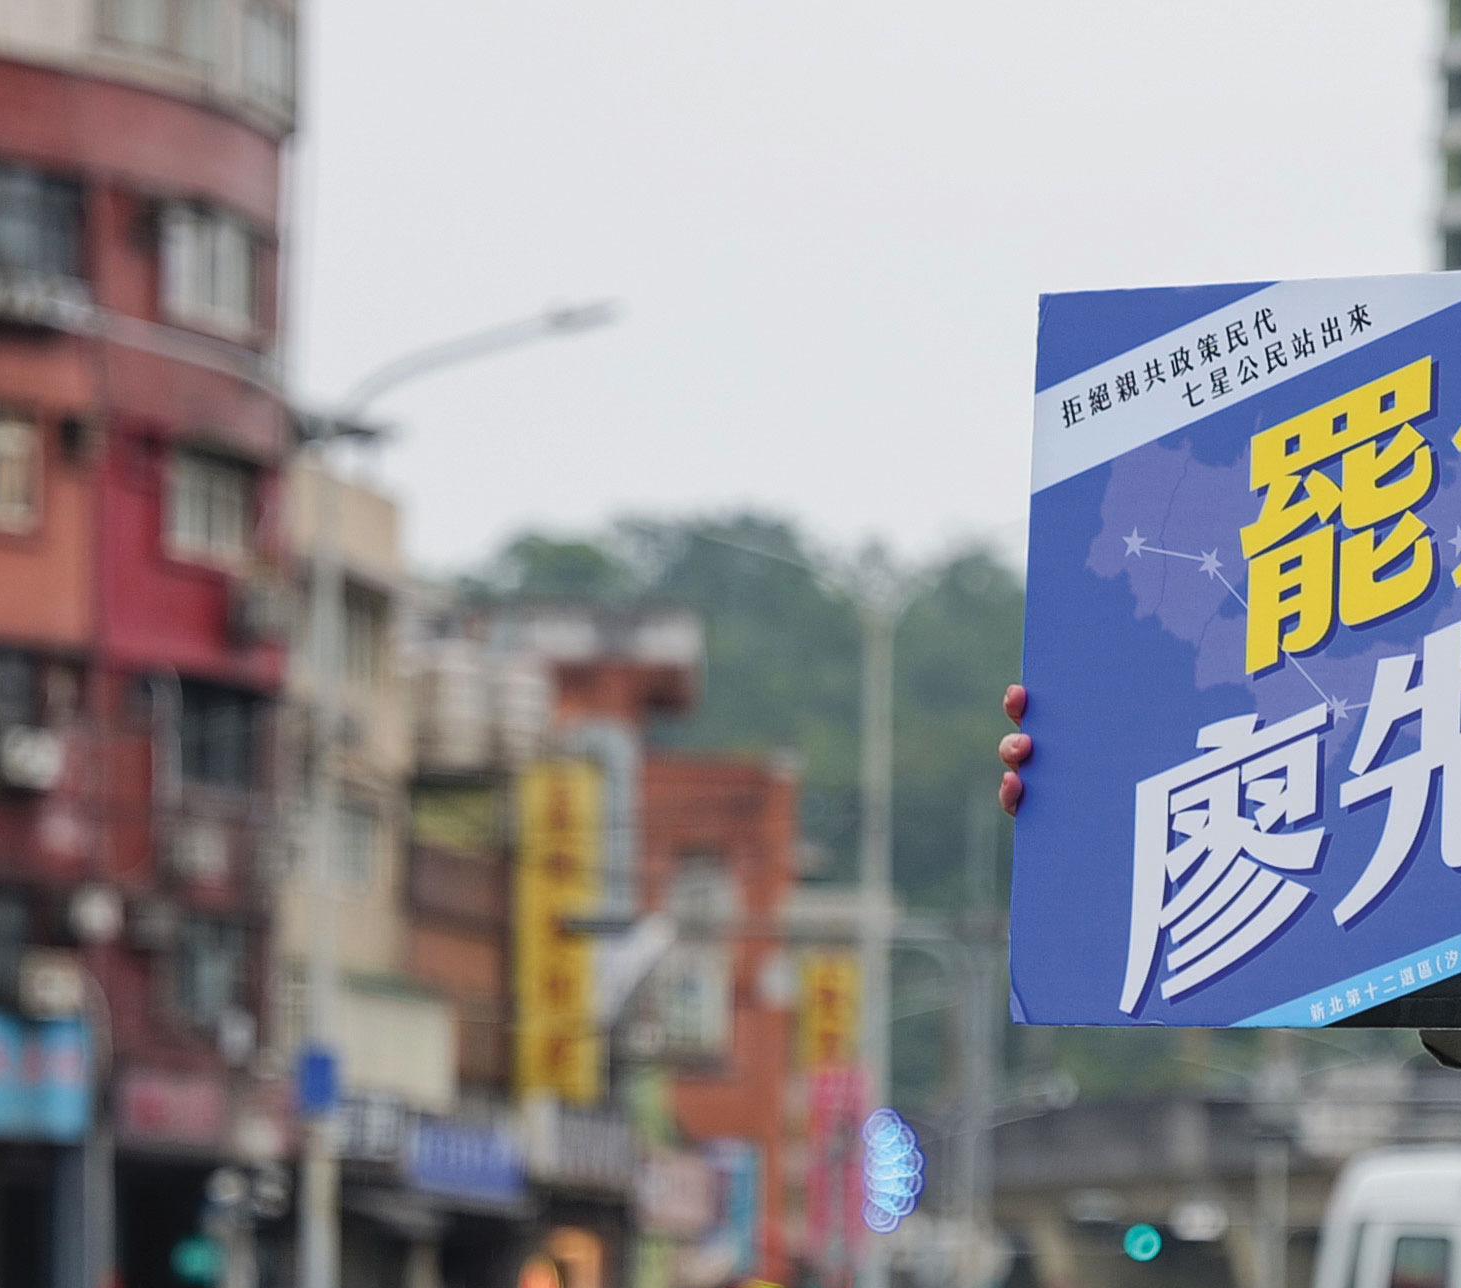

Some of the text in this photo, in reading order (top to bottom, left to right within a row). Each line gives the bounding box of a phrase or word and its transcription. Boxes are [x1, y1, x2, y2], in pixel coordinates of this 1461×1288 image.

[1060, 307, 1278, 429] 拒絕親共政策民代
[1182, 304, 1373, 408] 七星公民站出來
